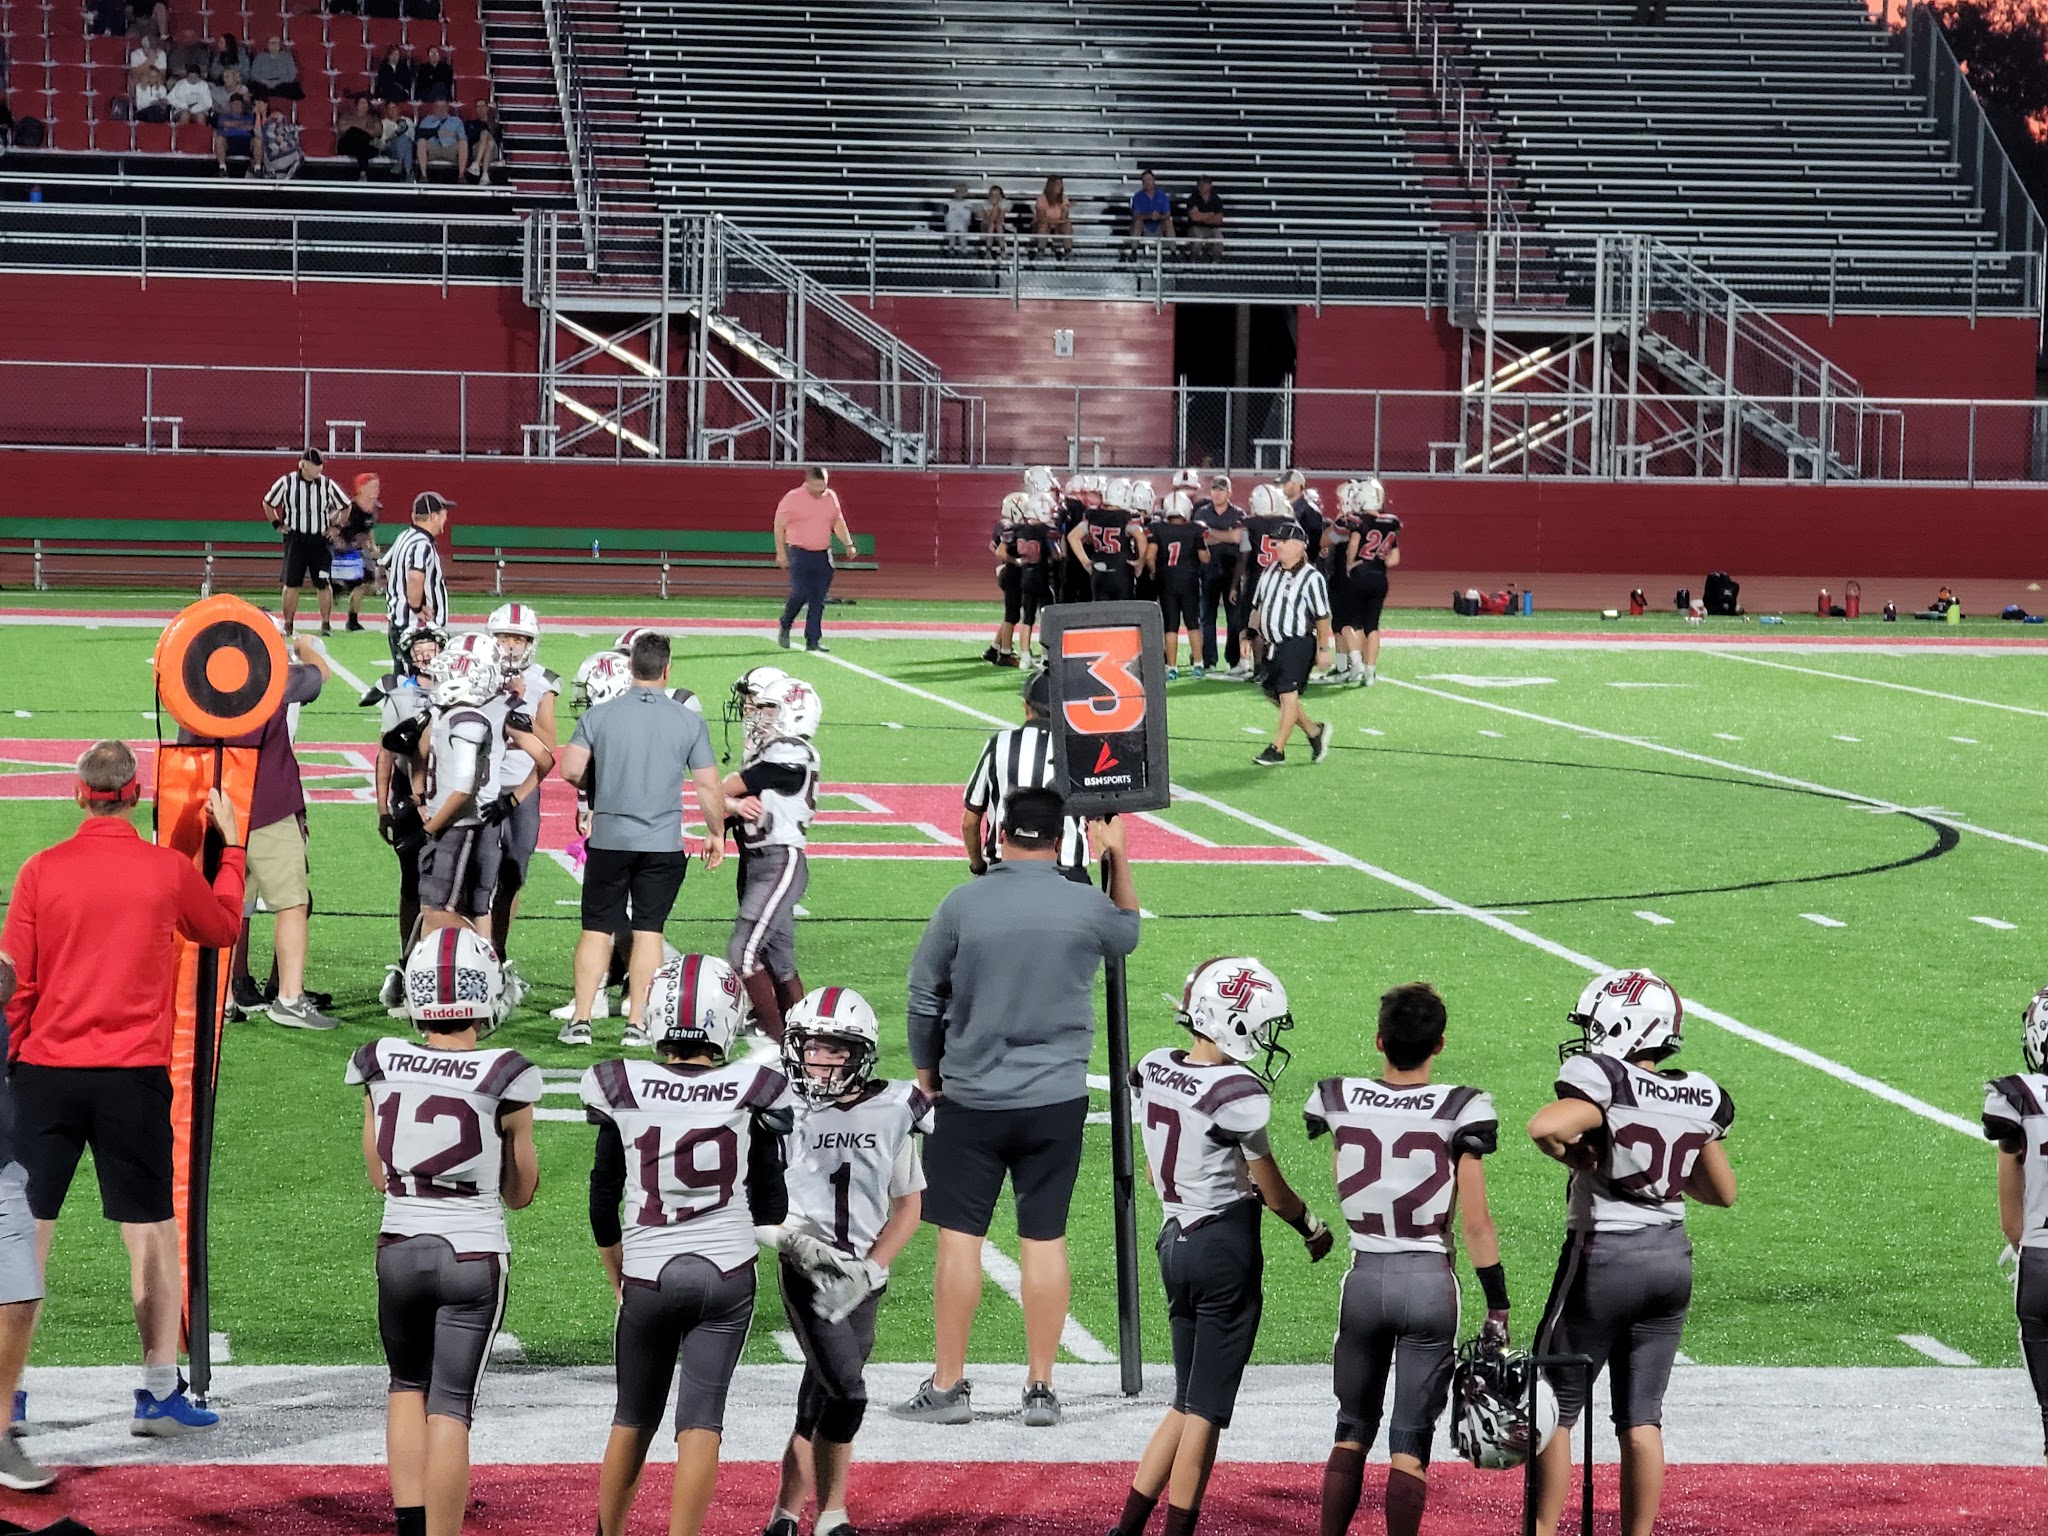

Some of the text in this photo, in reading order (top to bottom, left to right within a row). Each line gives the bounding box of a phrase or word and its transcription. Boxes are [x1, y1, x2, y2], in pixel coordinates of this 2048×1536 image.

[1168, 541, 1181, 567] 1
[1358, 529, 1396, 560] 24
[1062, 626, 1147, 735] 3
[423, 1007, 474, 1019] Riddell
[387, 1053, 481, 1080] TROJANS
[1145, 1061, 1203, 1096] TROJANS
[641, 1078, 739, 1103] TROJANS
[1350, 1087, 1436, 1110] TROJANS
[1635, 1076, 1714, 1107] TROJANS
[377, 1092, 483, 1199] 12
[812, 1132, 877, 1150] JENKS
[1147, 1101, 1183, 1203] 7
[634, 1125, 738, 1227] 19
[1335, 1125, 1451, 1239] 22
[829, 1162, 857, 1258] 1
